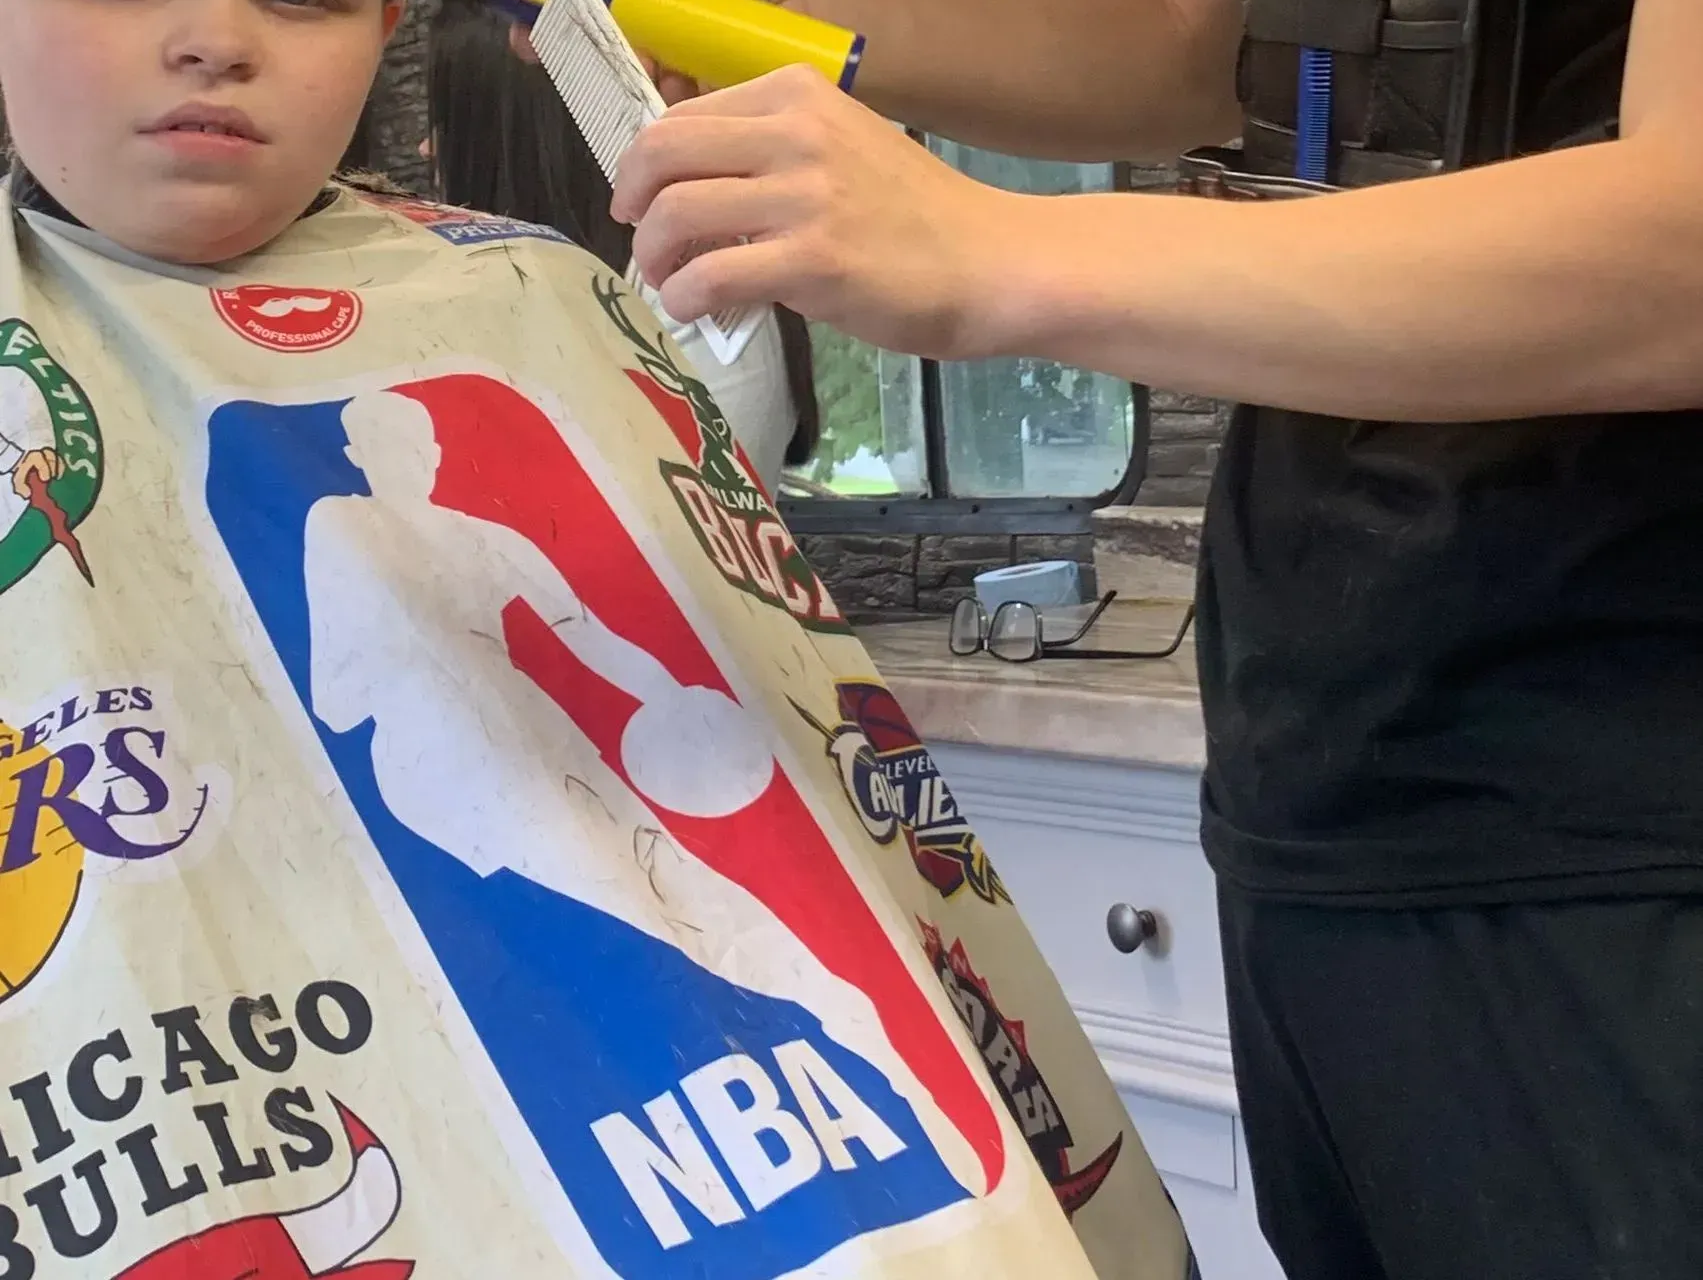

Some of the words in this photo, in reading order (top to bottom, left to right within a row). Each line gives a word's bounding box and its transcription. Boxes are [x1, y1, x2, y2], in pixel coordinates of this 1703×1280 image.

[246, 320, 336, 344] PROFESSIONAL
[334, 306, 351, 329] CAPE
[0, 326, 97, 479] ELTICS
[879, 754, 935, 779] LEVEL
[589, 1038, 908, 1250] NBA
